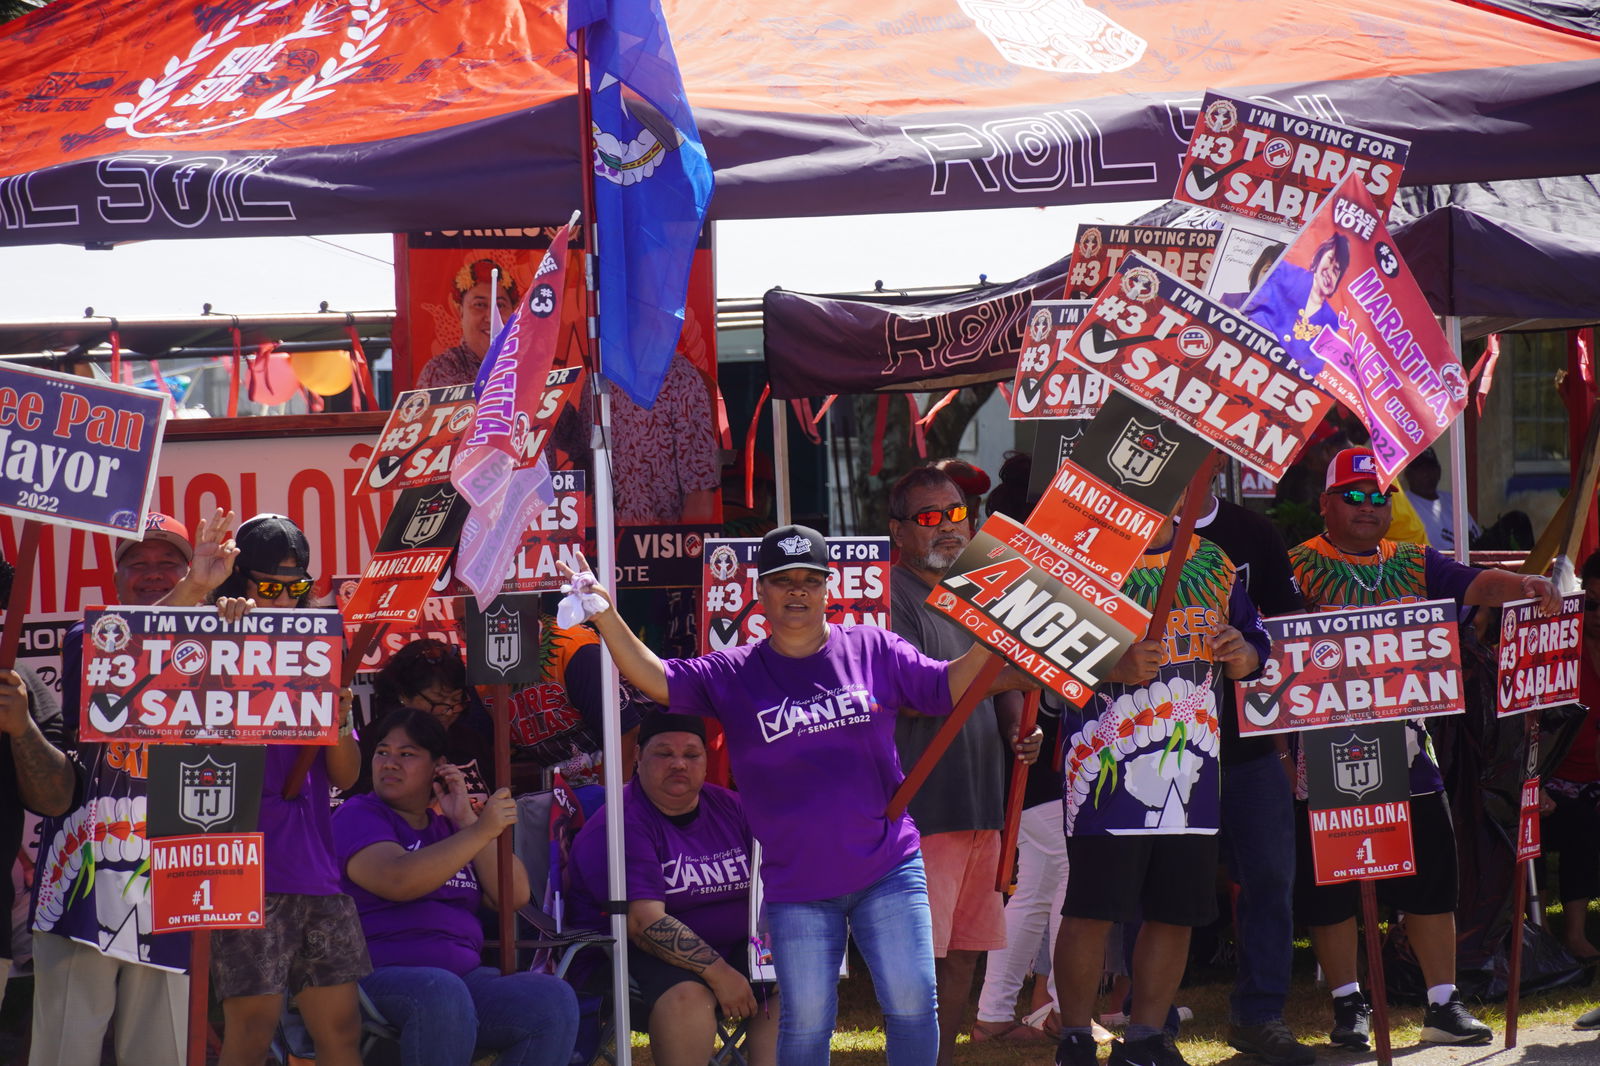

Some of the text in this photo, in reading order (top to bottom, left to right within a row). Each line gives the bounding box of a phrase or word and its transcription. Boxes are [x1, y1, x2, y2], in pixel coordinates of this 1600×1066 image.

[1249, 108, 1396, 160] I'M VOTING FOR
[900, 108, 1157, 196] ROIL
[1190, 133, 1235, 166] #3
[1220, 203, 1236, 212] PAID
[1236, 206, 1249, 215] FOR
[1337, 198, 1377, 230] PLEASE
[1109, 229, 1129, 244] I'M
[1134, 229, 1185, 246] VOTING
[1188, 232, 1216, 247] FOR
[1333, 208, 1372, 241] VOTE
[1070, 260, 1101, 287] #3
[1378, 244, 1398, 275] #3
[530, 288, 554, 314] #3
[1060, 308, 1079, 324] I'M
[1095, 295, 1148, 334] #3
[1169, 287, 1291, 364] I'M VOTING
[1021, 343, 1051, 372] #3
[1156, 306, 1321, 423] TORRES
[440, 387, 467, 401] I'M
[1121, 347, 1299, 467] SABLAN
[53, 392, 145, 452] Pan
[1114, 373, 1129, 385] PAID
[1130, 382, 1144, 394] FOR
[1144, 391, 1153, 399] BY
[1192, 418, 1201, 428] TO
[1223, 437, 1249, 456] TORRES
[1249, 453, 1275, 471] SABLAN
[1384, 395, 1425, 444] ULLOA
[380, 423, 423, 452] #3
[1122, 445, 1154, 477] TJ
[17, 491, 60, 514] 2022
[1055, 470, 1156, 540] MANGLOÑA
[412, 516, 438, 540] TJ
[1062, 499, 1132, 541] FOR CONGRESS
[847, 544, 880, 560] FOR
[1041, 533, 1109, 575] ON THE BALLOT
[1074, 527, 1100, 553] #1
[365, 553, 443, 578] MANGLOÑA
[706, 582, 743, 612] #3
[1563, 598, 1580, 614] FOR
[144, 615, 327, 634] I'M VOTING FOR
[377, 609, 405, 617] BALLOT
[1282, 607, 1445, 637] I'M VOTING FOR
[494, 636, 512, 662] TJ
[959, 607, 1061, 682] for SENATE
[1284, 627, 1452, 673] TORRES
[1518, 617, 1580, 658] TORRES
[86, 654, 136, 687] #3
[142, 639, 332, 677] TORRES
[1500, 642, 1517, 671] #3
[1289, 669, 1459, 717] SABLAN
[1515, 659, 1579, 700] SABLAN
[138, 690, 333, 727] SABLAN
[1381, 708, 1402, 716] ELECT
[1404, 705, 1429, 714] TORRES
[1430, 702, 1456, 710] SABLAN
[808, 718, 846, 734] SENATE
[848, 714, 871, 725] 2022
[1345, 761, 1370, 787] TJ
[194, 789, 222, 817] TJ
[1313, 803, 1407, 832] MANGLOÑA
[153, 840, 259, 871] MANGLOÑA
[1356, 837, 1376, 864] #1
[1333, 863, 1399, 877] ON THE BALLOT
[192, 880, 213, 911] #1
[460, 881, 478, 890] 2022
[700, 884, 732, 895] SENATE
[168, 913, 242, 925] ON THE BALLOT
